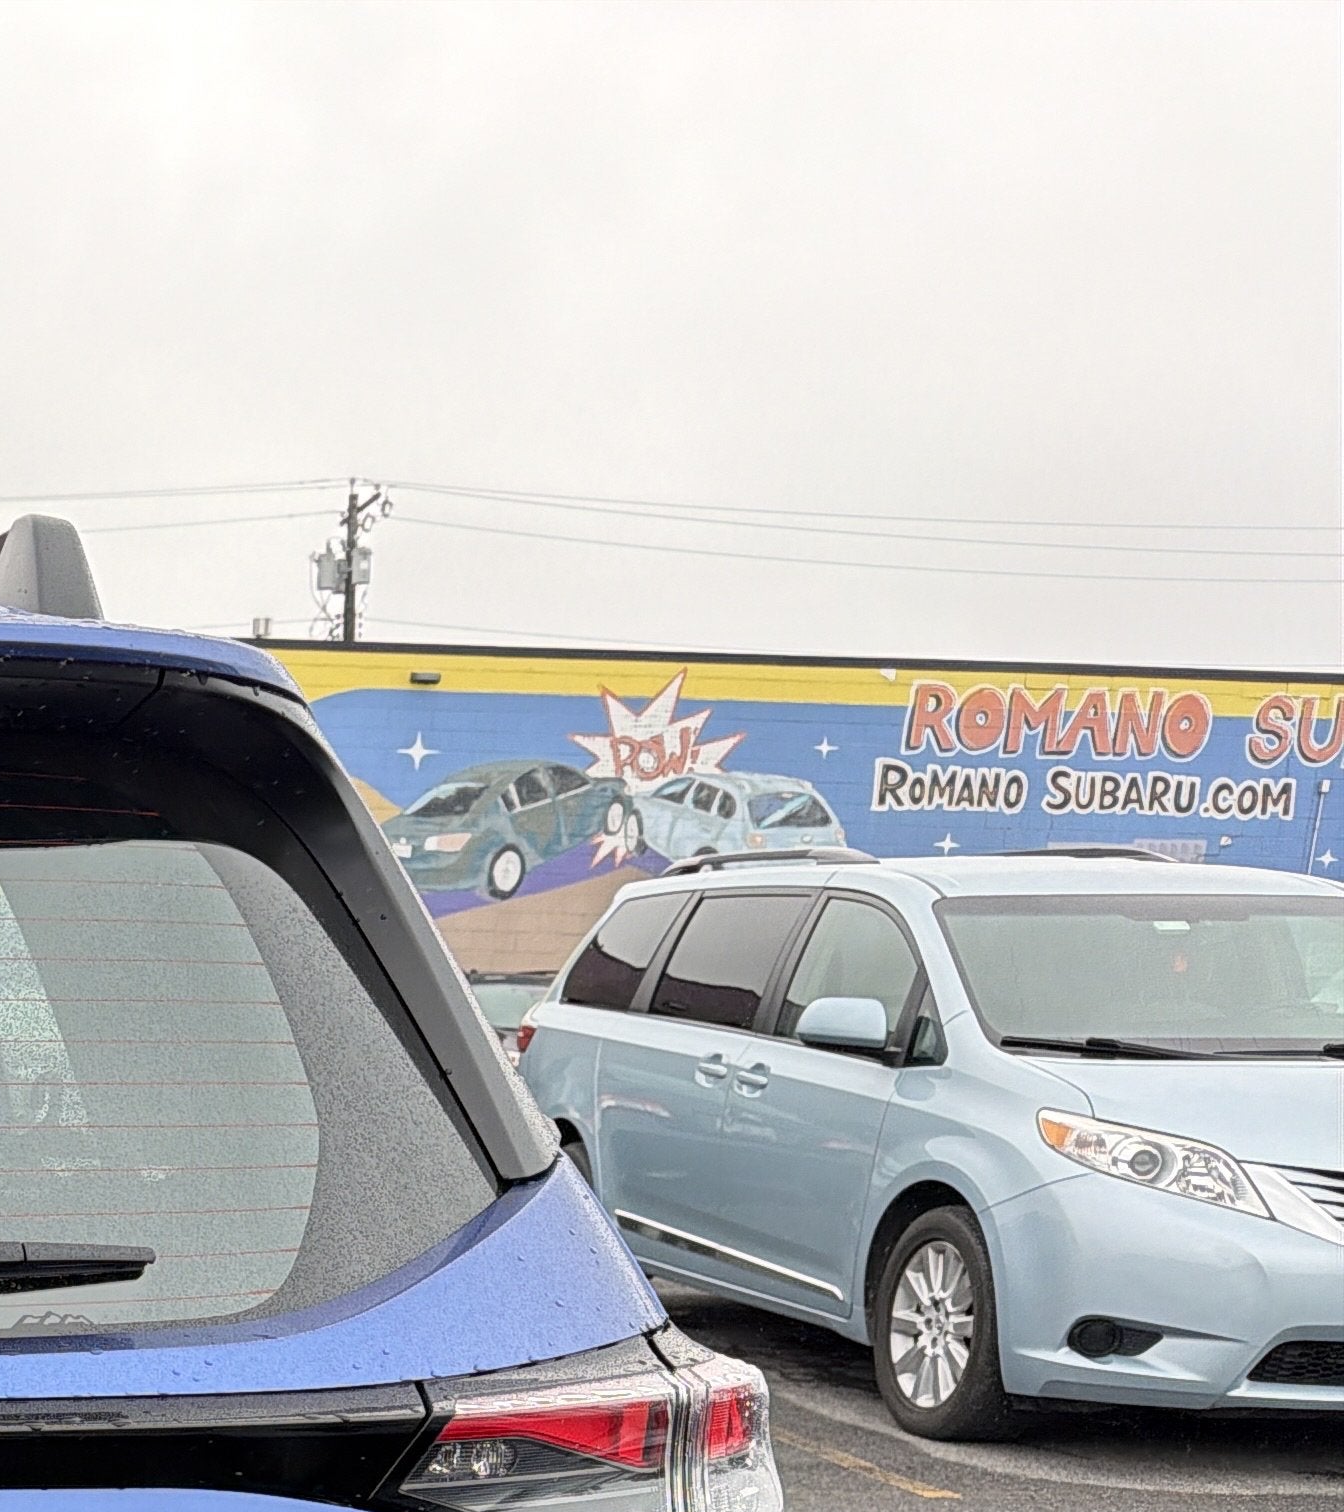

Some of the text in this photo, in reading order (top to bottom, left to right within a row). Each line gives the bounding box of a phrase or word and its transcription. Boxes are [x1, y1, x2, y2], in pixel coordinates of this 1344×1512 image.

[610, 726, 700, 780] POW!
[905, 682, 1344, 765] ROMANO SU
